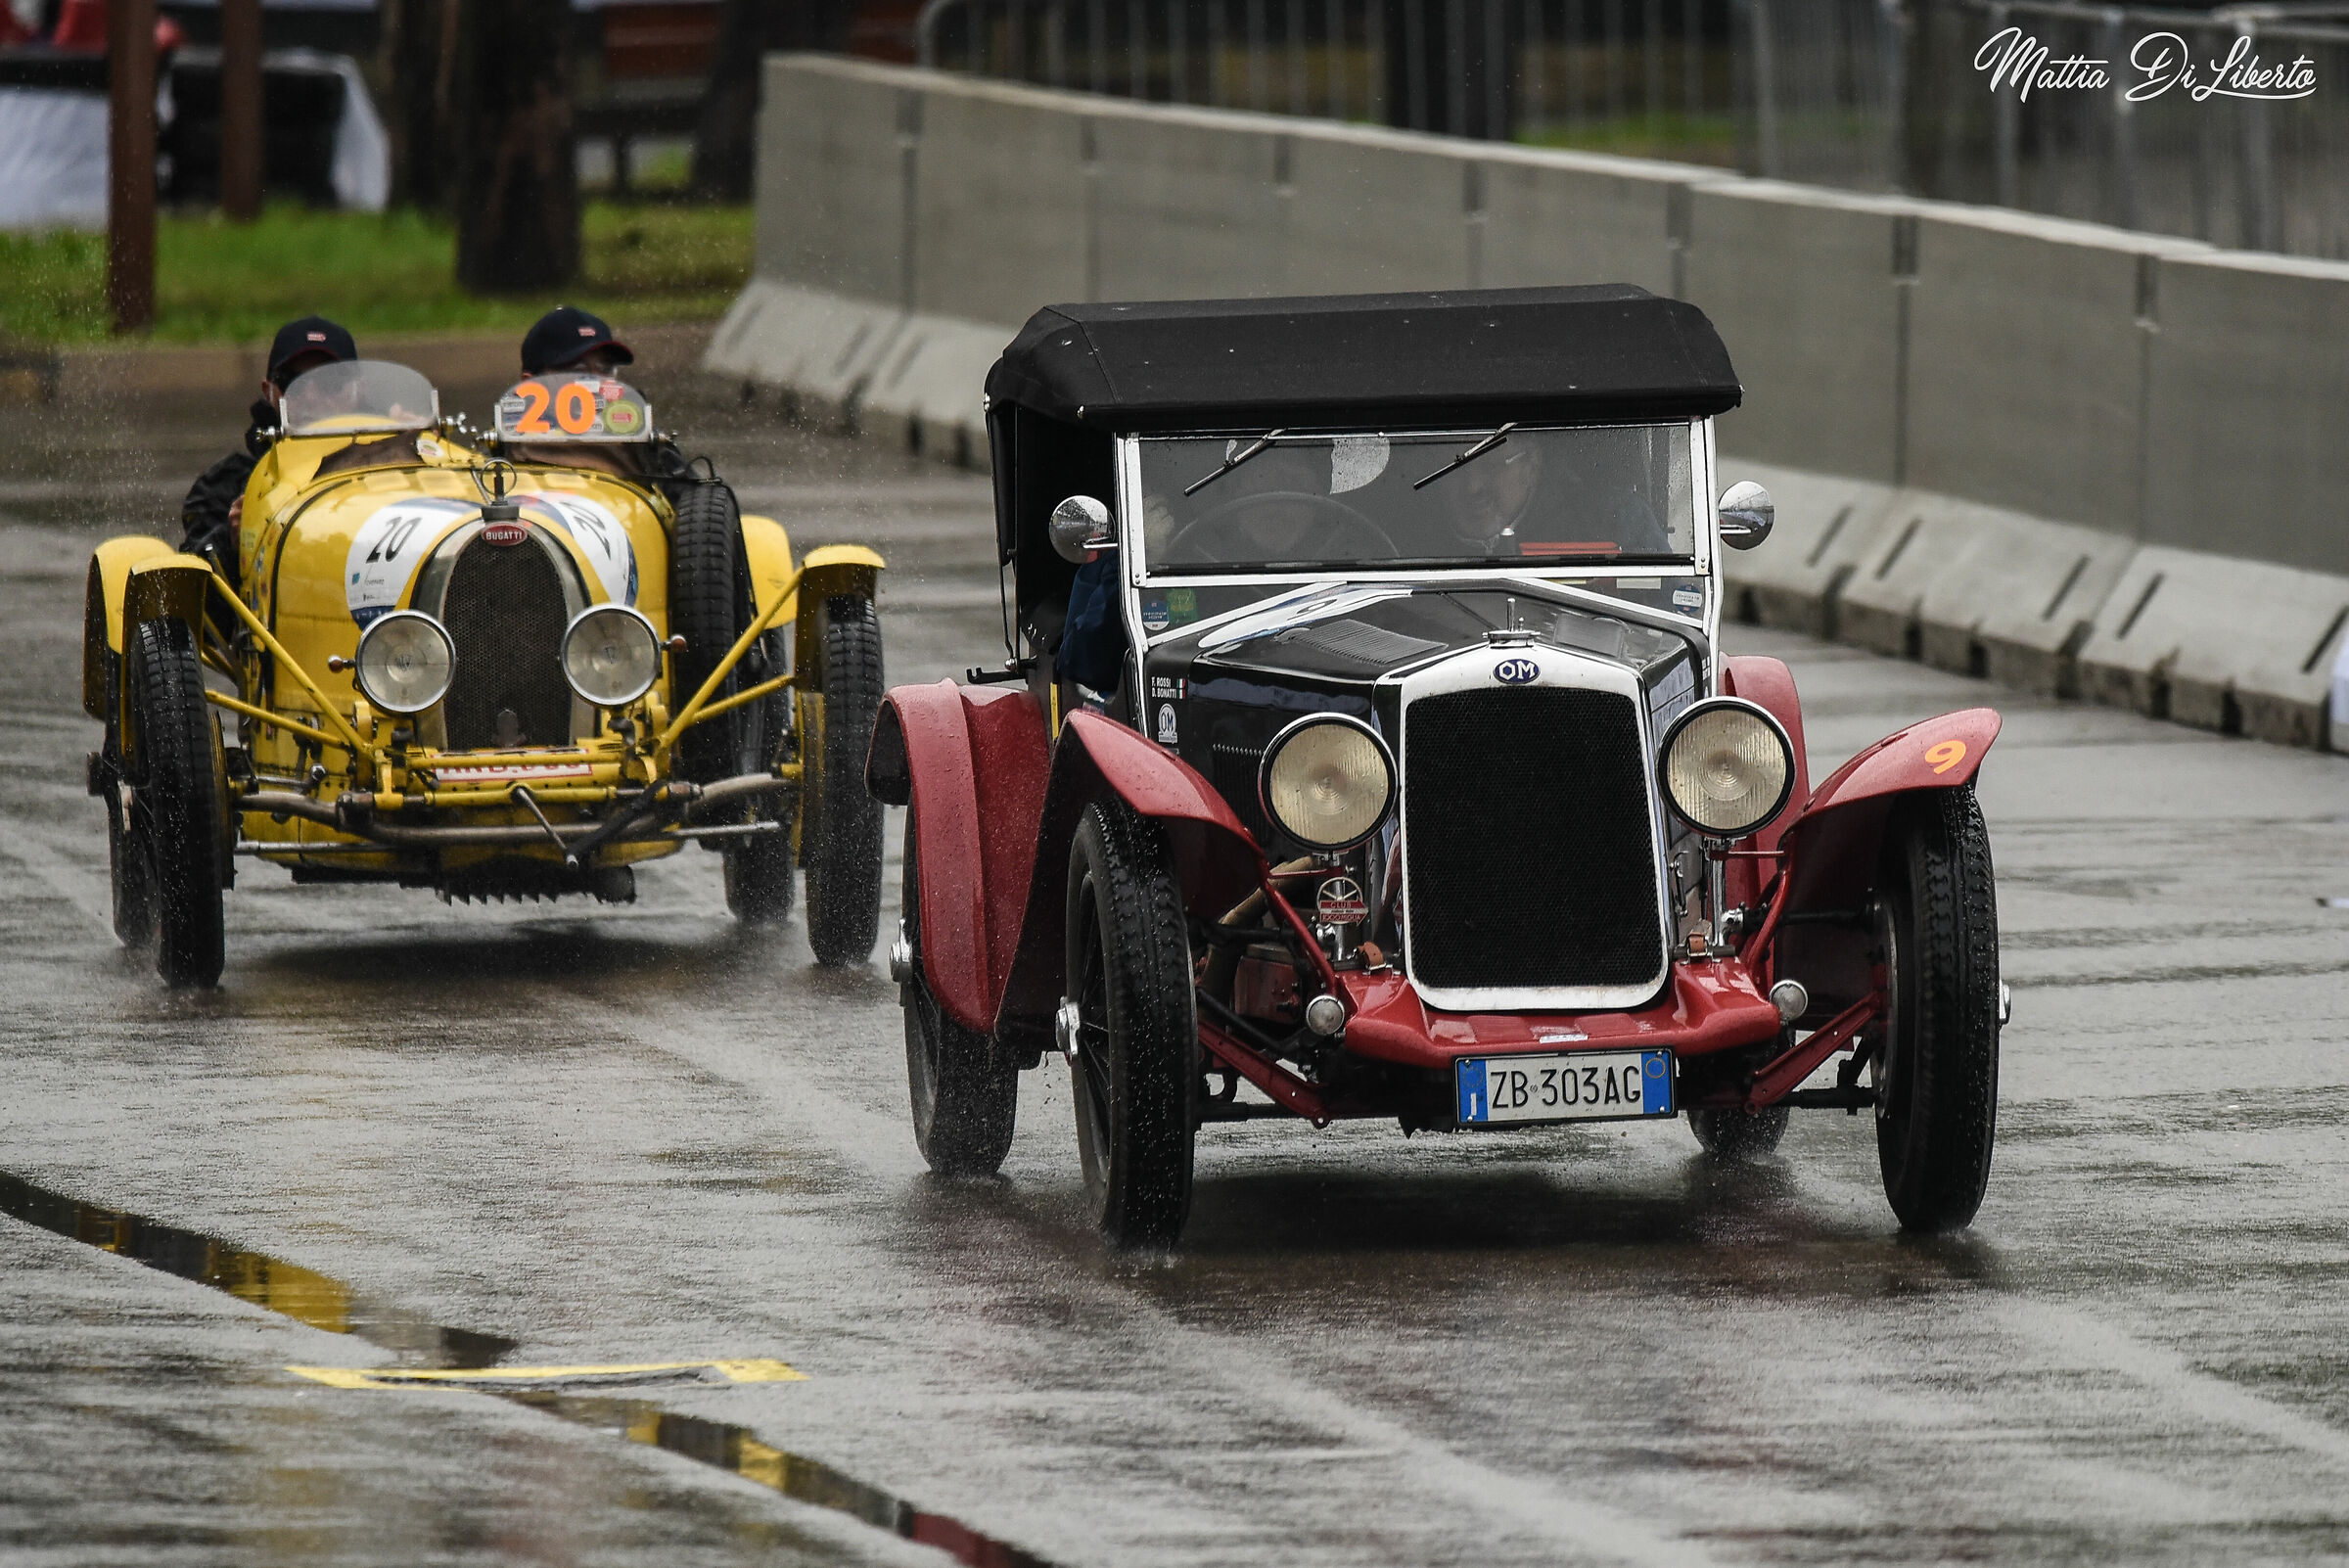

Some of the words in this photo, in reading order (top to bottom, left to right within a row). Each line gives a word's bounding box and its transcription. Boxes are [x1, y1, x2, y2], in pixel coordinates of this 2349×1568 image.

[515, 381, 596, 435] 20
[365, 516, 423, 564] 20
[485, 531, 523, 540] BUGATTI
[1156, 676, 1172, 688] ROSSI
[1498, 660, 1536, 680] OM
[1924, 739, 1966, 774] 9
[1490, 1071, 1529, 1109] ZB
[1540, 1065, 1642, 1107] 303AG
